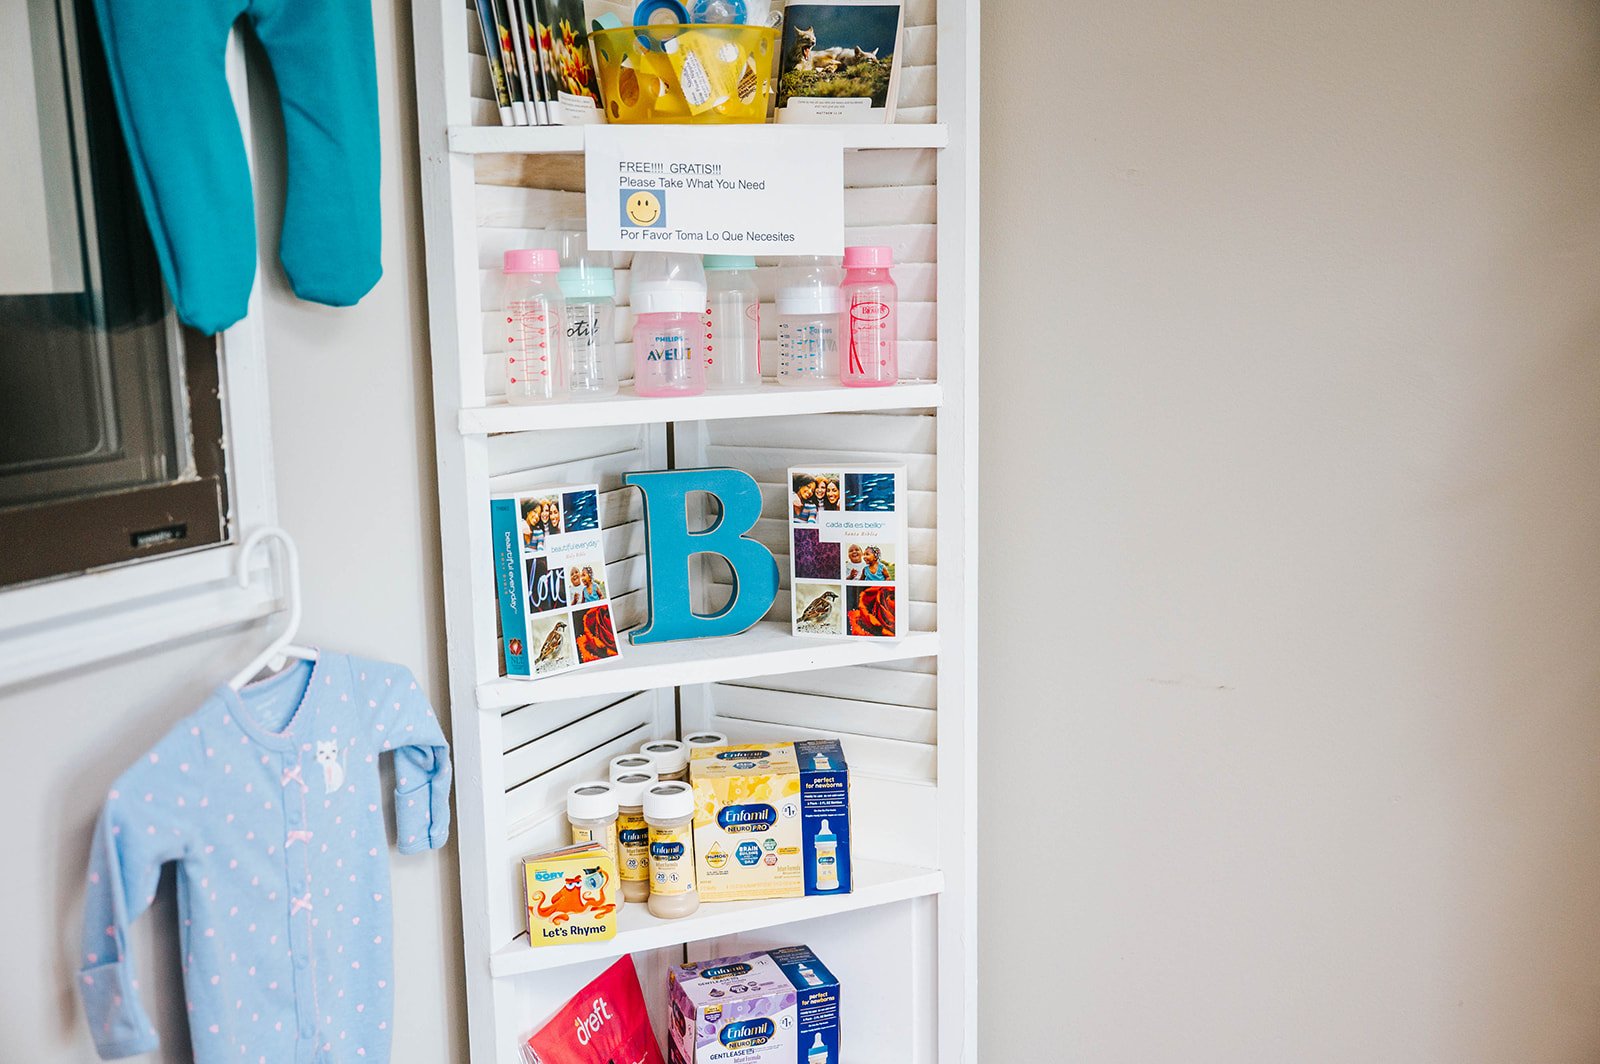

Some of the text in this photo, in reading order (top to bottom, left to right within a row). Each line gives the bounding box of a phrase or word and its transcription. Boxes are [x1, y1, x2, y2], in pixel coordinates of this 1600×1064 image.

[619, 161, 722, 175] FREE!!!! GRATIS!!!
[619, 176, 765, 190] Please Take What You Need
[620, 229, 795, 242] Por Favor Toma Lo Que Necesites
[825, 521, 843, 529] cada
[623, 466, 780, 646] B
[725, 808, 769, 822] Enfamil
[727, 824, 768, 833] NEURO PRO
[535, 871, 564, 882] DORY
[542, 924, 607, 938] Let's Rhyme
[808, 992, 828, 1001] perfect
[810, 996, 835, 1005] newborns
[576, 997, 613, 1046] dreft
[727, 1022, 768, 1040] Enfamil
[728, 1040, 751, 1049] NEURO
[709, 1049, 746, 1061] GENTLEASE
